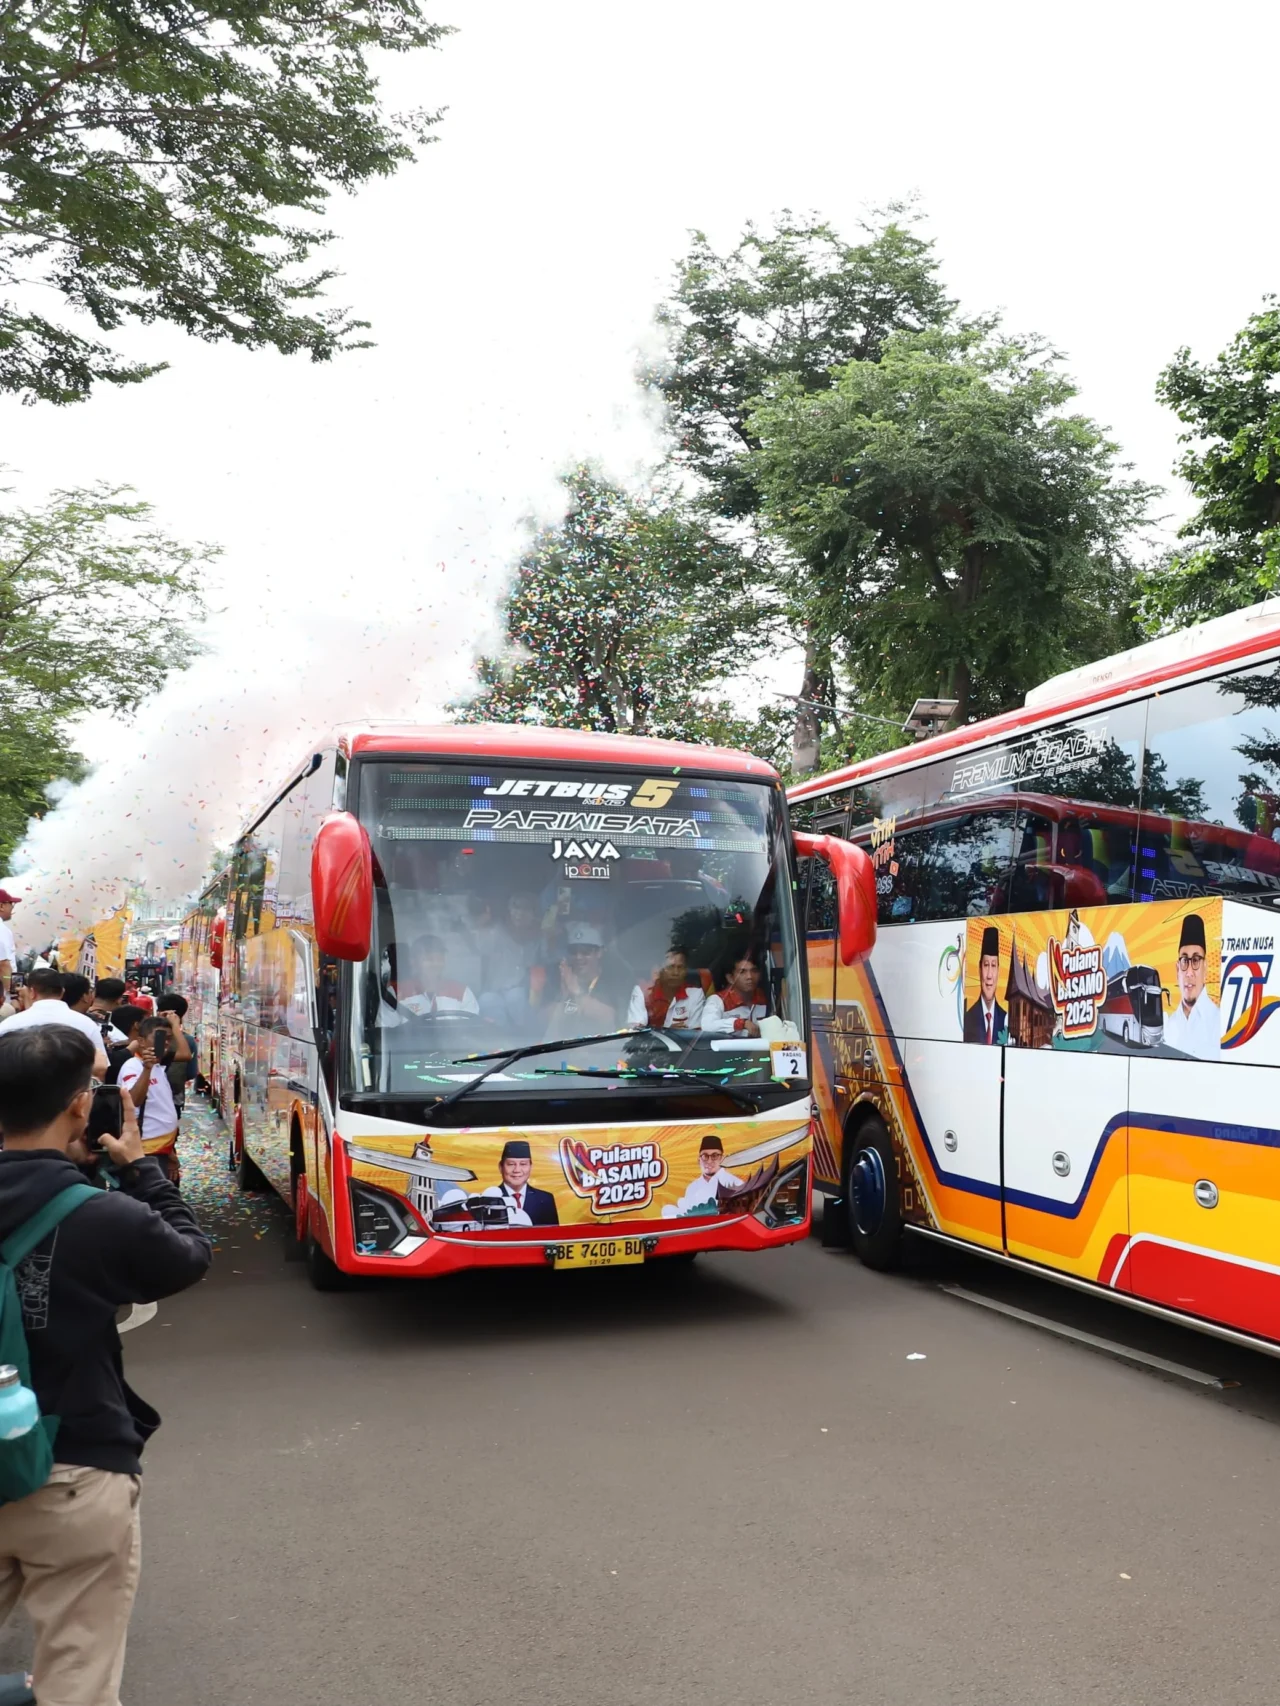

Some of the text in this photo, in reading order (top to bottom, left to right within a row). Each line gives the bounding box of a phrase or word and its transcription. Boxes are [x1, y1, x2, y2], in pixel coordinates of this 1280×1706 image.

[950, 727, 1107, 791] PREMIUM COACH
[484, 778, 680, 808] JETBUS 5
[463, 809, 701, 838] PARIWISATA
[551, 839, 621, 860] JAVA
[1227, 937, 1251, 951] TRANS
[1253, 936, 1274, 950] NUSA
[1062, 950, 1099, 974] Pulang
[1057, 971, 1103, 1002] BASAMO
[1066, 998, 1094, 1026] 2025
[790, 1058, 799, 1075] 2
[590, 1145, 653, 1166] Pulang
[582, 1160, 661, 1188] BASAMO
[598, 1181, 646, 1205] 2025
[557, 1241, 642, 1260] BE 7400 BU
